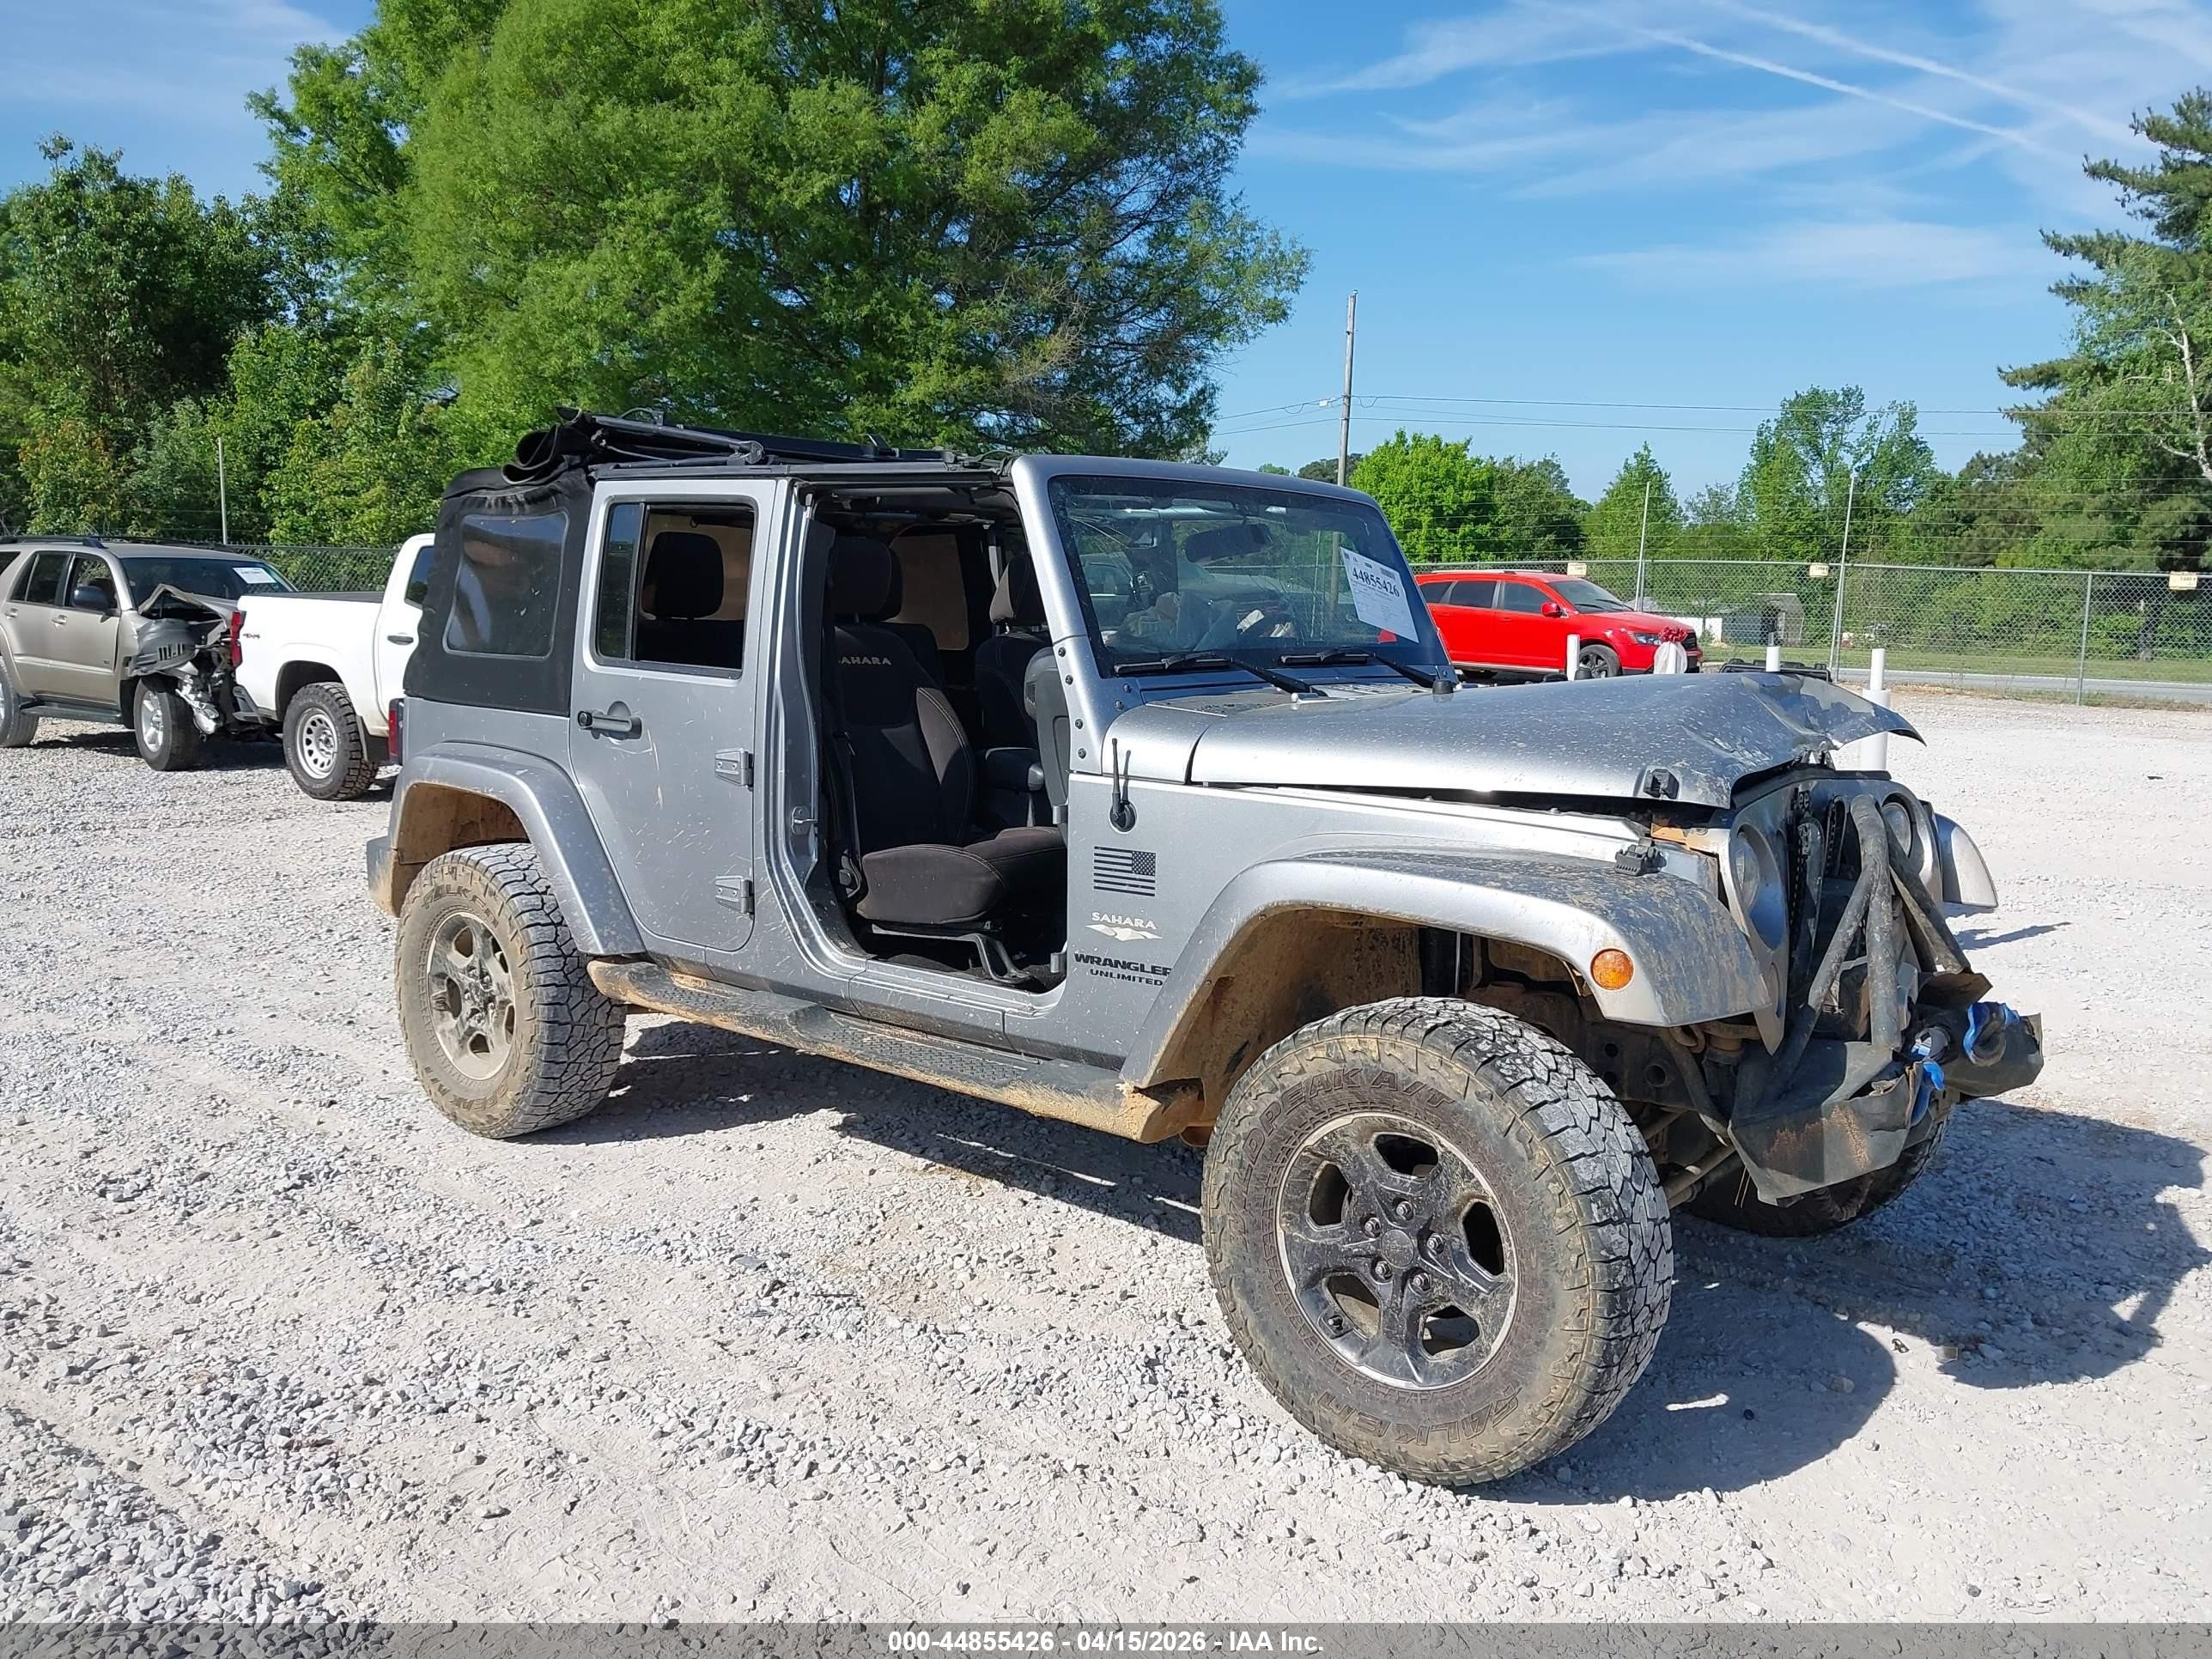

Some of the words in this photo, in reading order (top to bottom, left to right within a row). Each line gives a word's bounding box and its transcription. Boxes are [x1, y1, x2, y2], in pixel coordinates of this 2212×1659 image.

[1352, 567, 1401, 598] 44855426
[837, 656, 892, 665] AHARA
[1091, 911, 1158, 930] SAHARA
[1090, 969, 1164, 987] UNLIMITED
